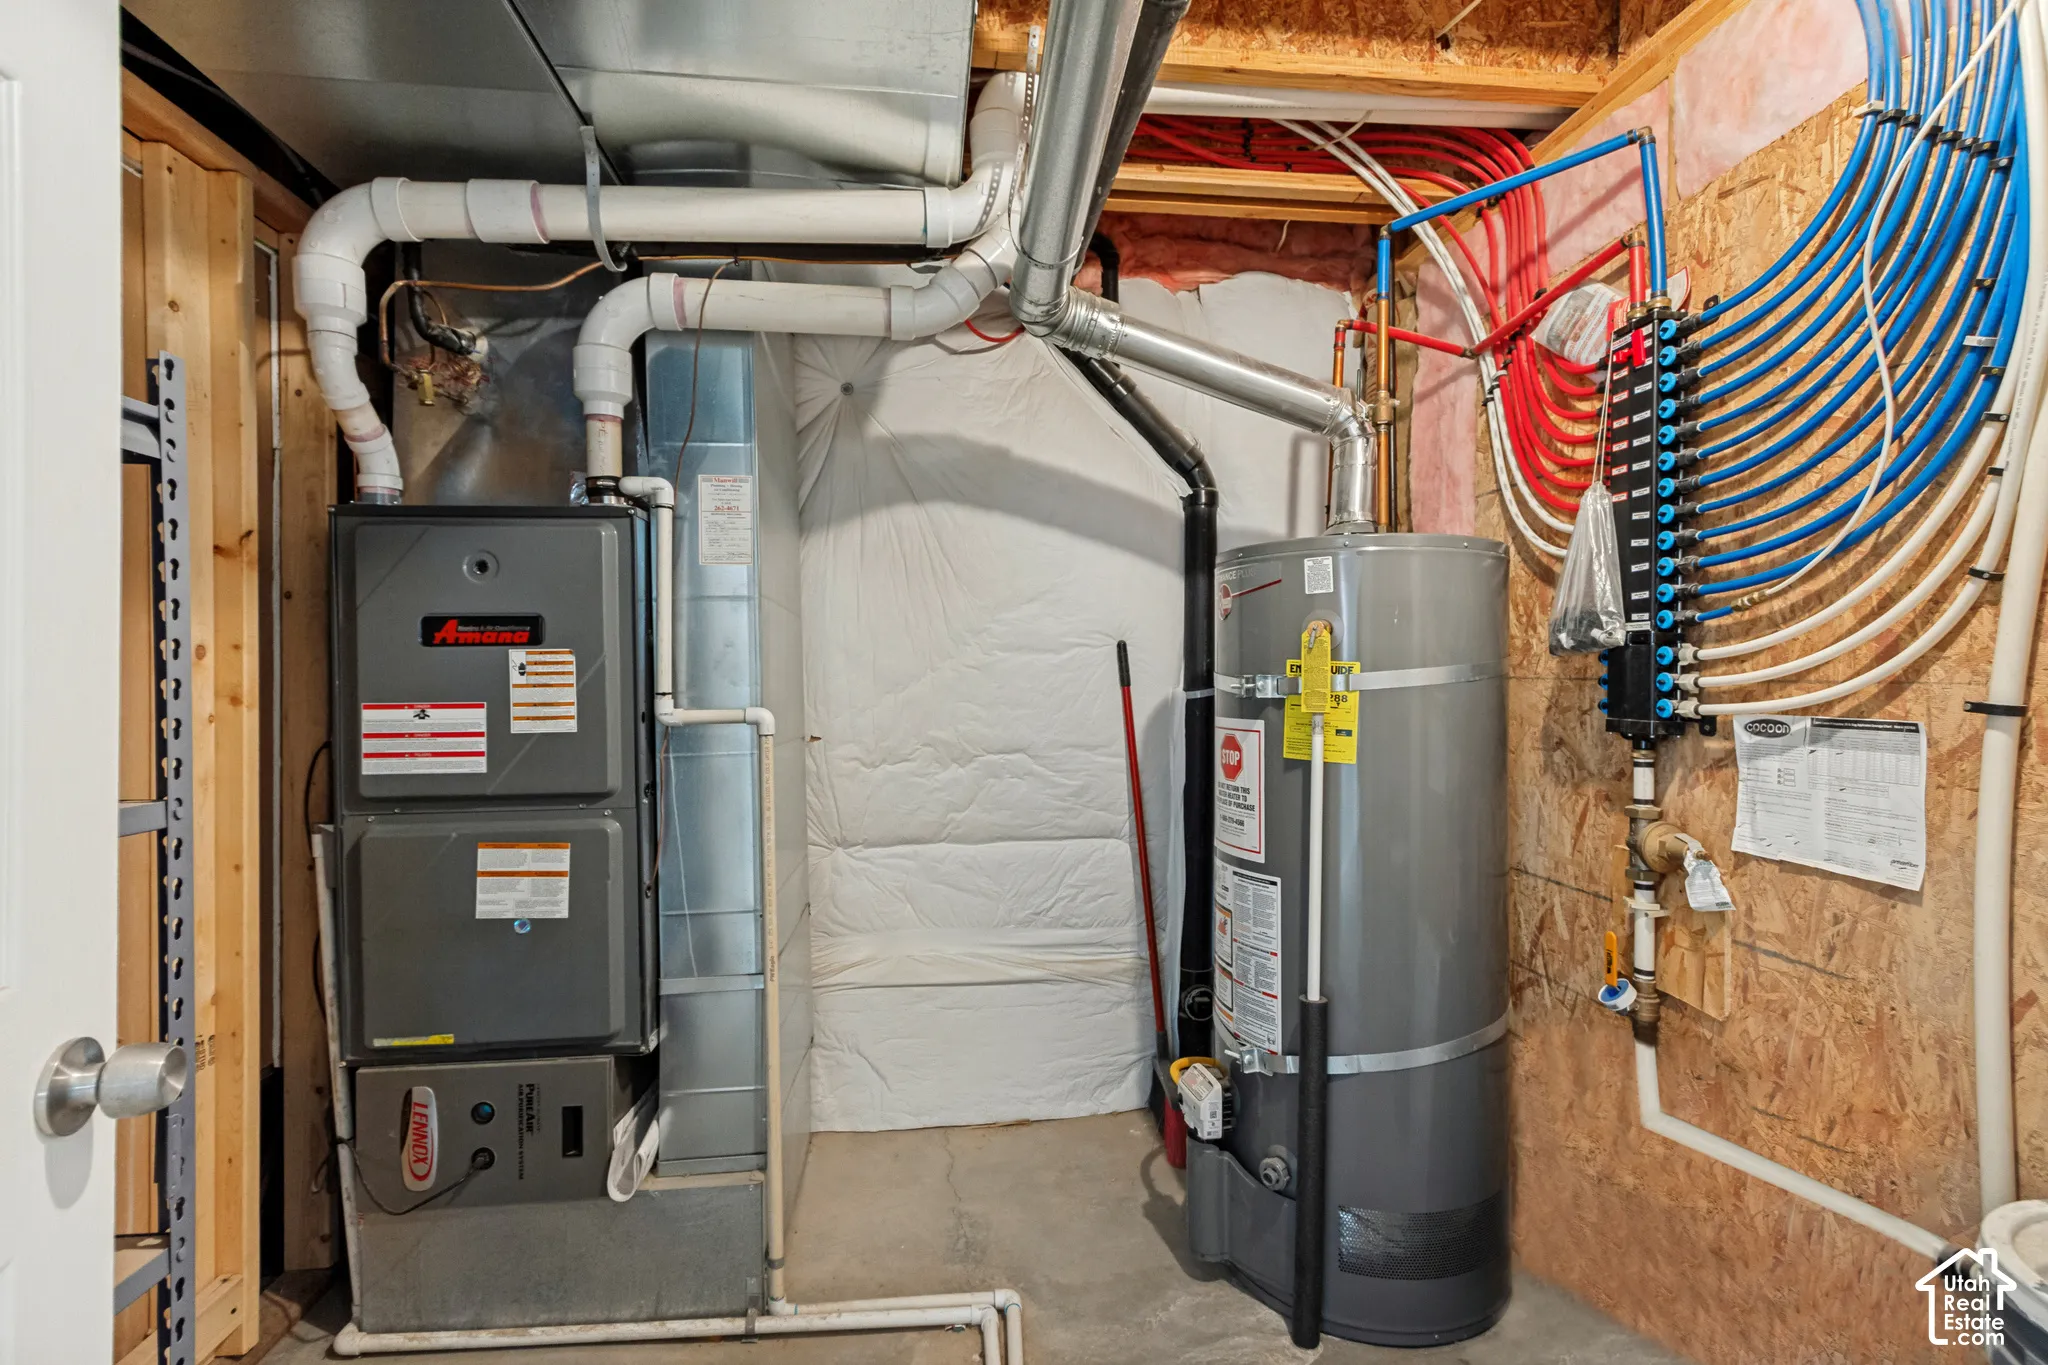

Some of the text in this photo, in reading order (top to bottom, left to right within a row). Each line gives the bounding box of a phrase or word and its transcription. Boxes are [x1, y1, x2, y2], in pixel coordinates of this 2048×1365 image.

[433, 619, 531, 644] Amana
[1746, 722, 1790, 734] cocoon
[1222, 749, 1240, 766] STOP
[1240, 786, 1250, 794] THIS
[1233, 801, 1256, 812] PURCHASE
[412, 1102, 428, 1165] LENNOX
